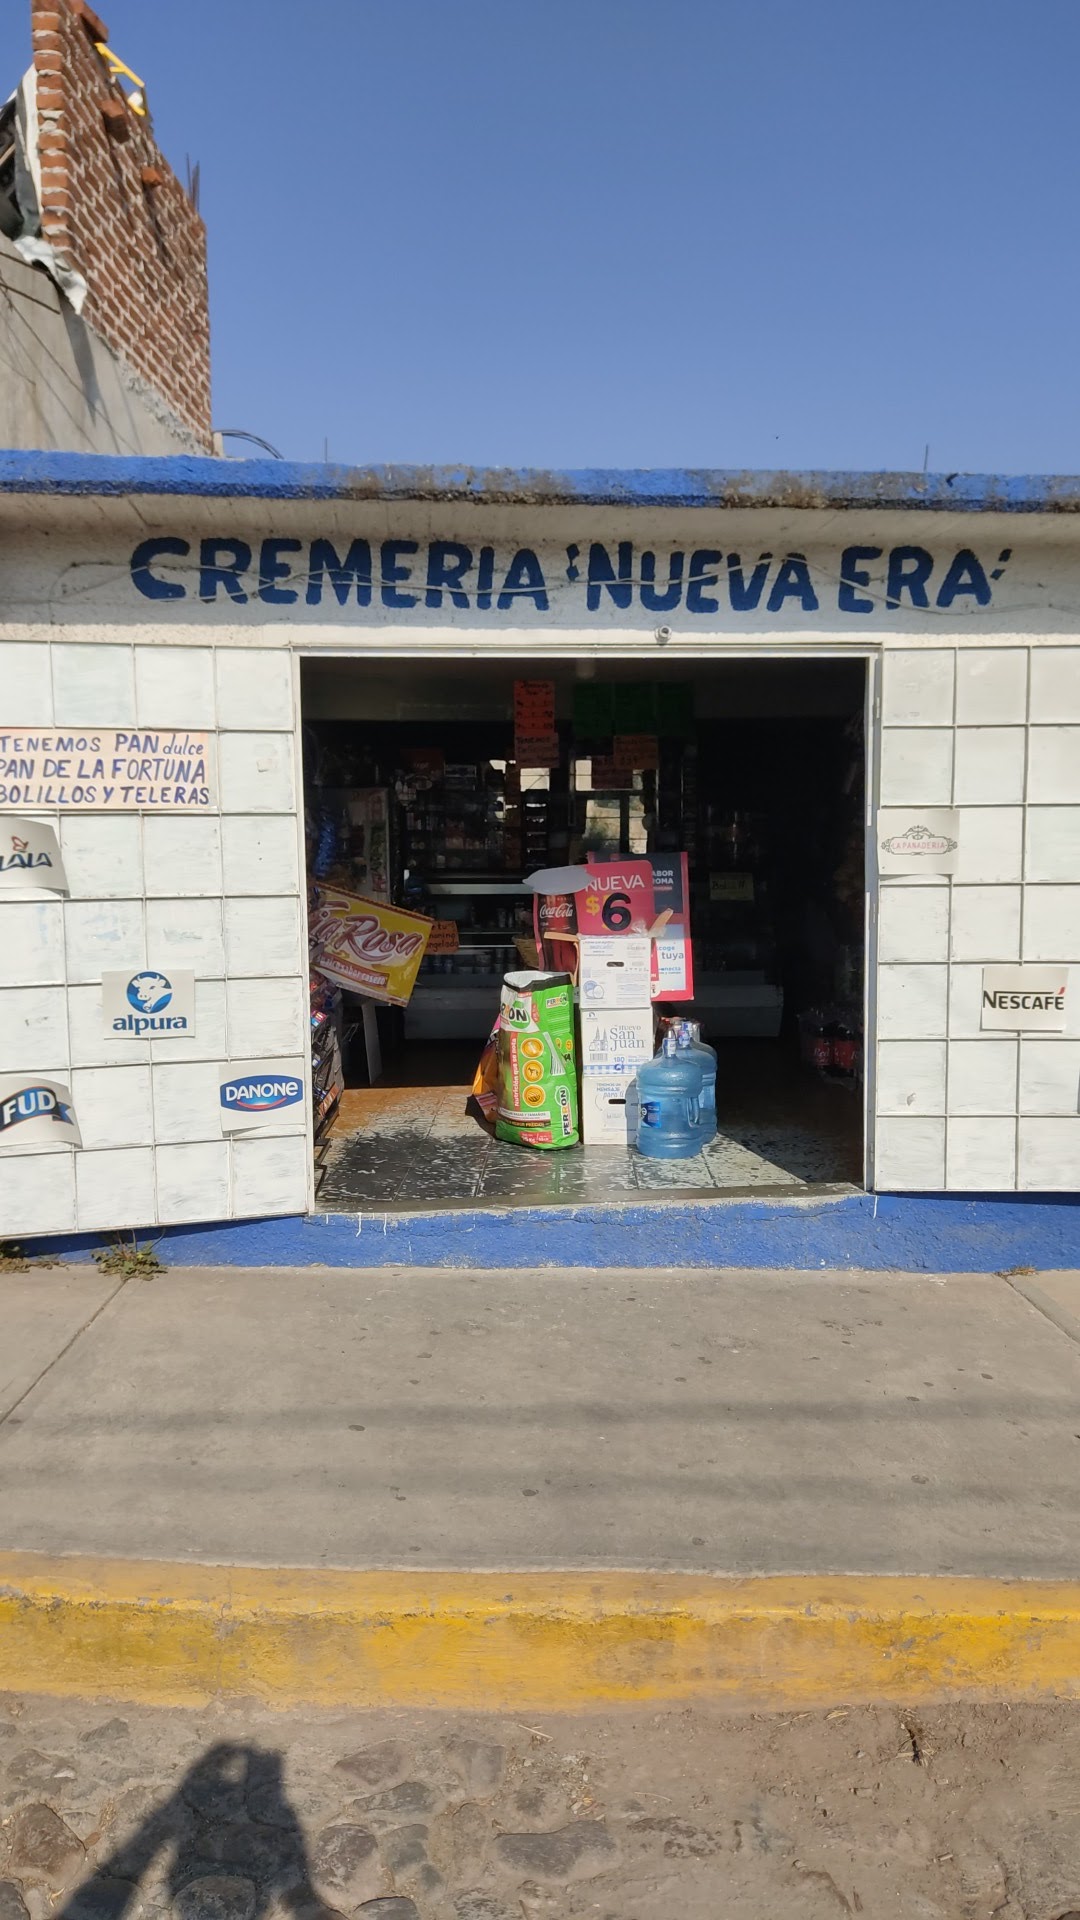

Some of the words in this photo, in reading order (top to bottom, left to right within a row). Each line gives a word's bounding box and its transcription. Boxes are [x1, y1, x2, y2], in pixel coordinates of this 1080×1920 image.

[130, 537, 549, 611] CREMERIA
[0, 735, 101, 753] TENEMOS
[115, 733, 159, 754] PAN
[163, 734, 203, 755] dulce
[43, 759, 72, 778] DE
[77, 759, 105, 779] LA
[111, 758, 205, 784] FORTUNA
[103, 786, 114, 804] Y
[120, 786, 209, 805] TELERAS
[585, 875, 645, 892] NUEVA
[334, 915, 423, 961] Rosa
[661, 952, 684, 960] tuya
[982, 987, 1066, 1010] NESCAFÉ
[112, 1015, 187, 1036] alpura
[609, 1027, 635, 1039] San
[610, 1039, 645, 1052] Juan
[3, 1091, 56, 1125] FUD
